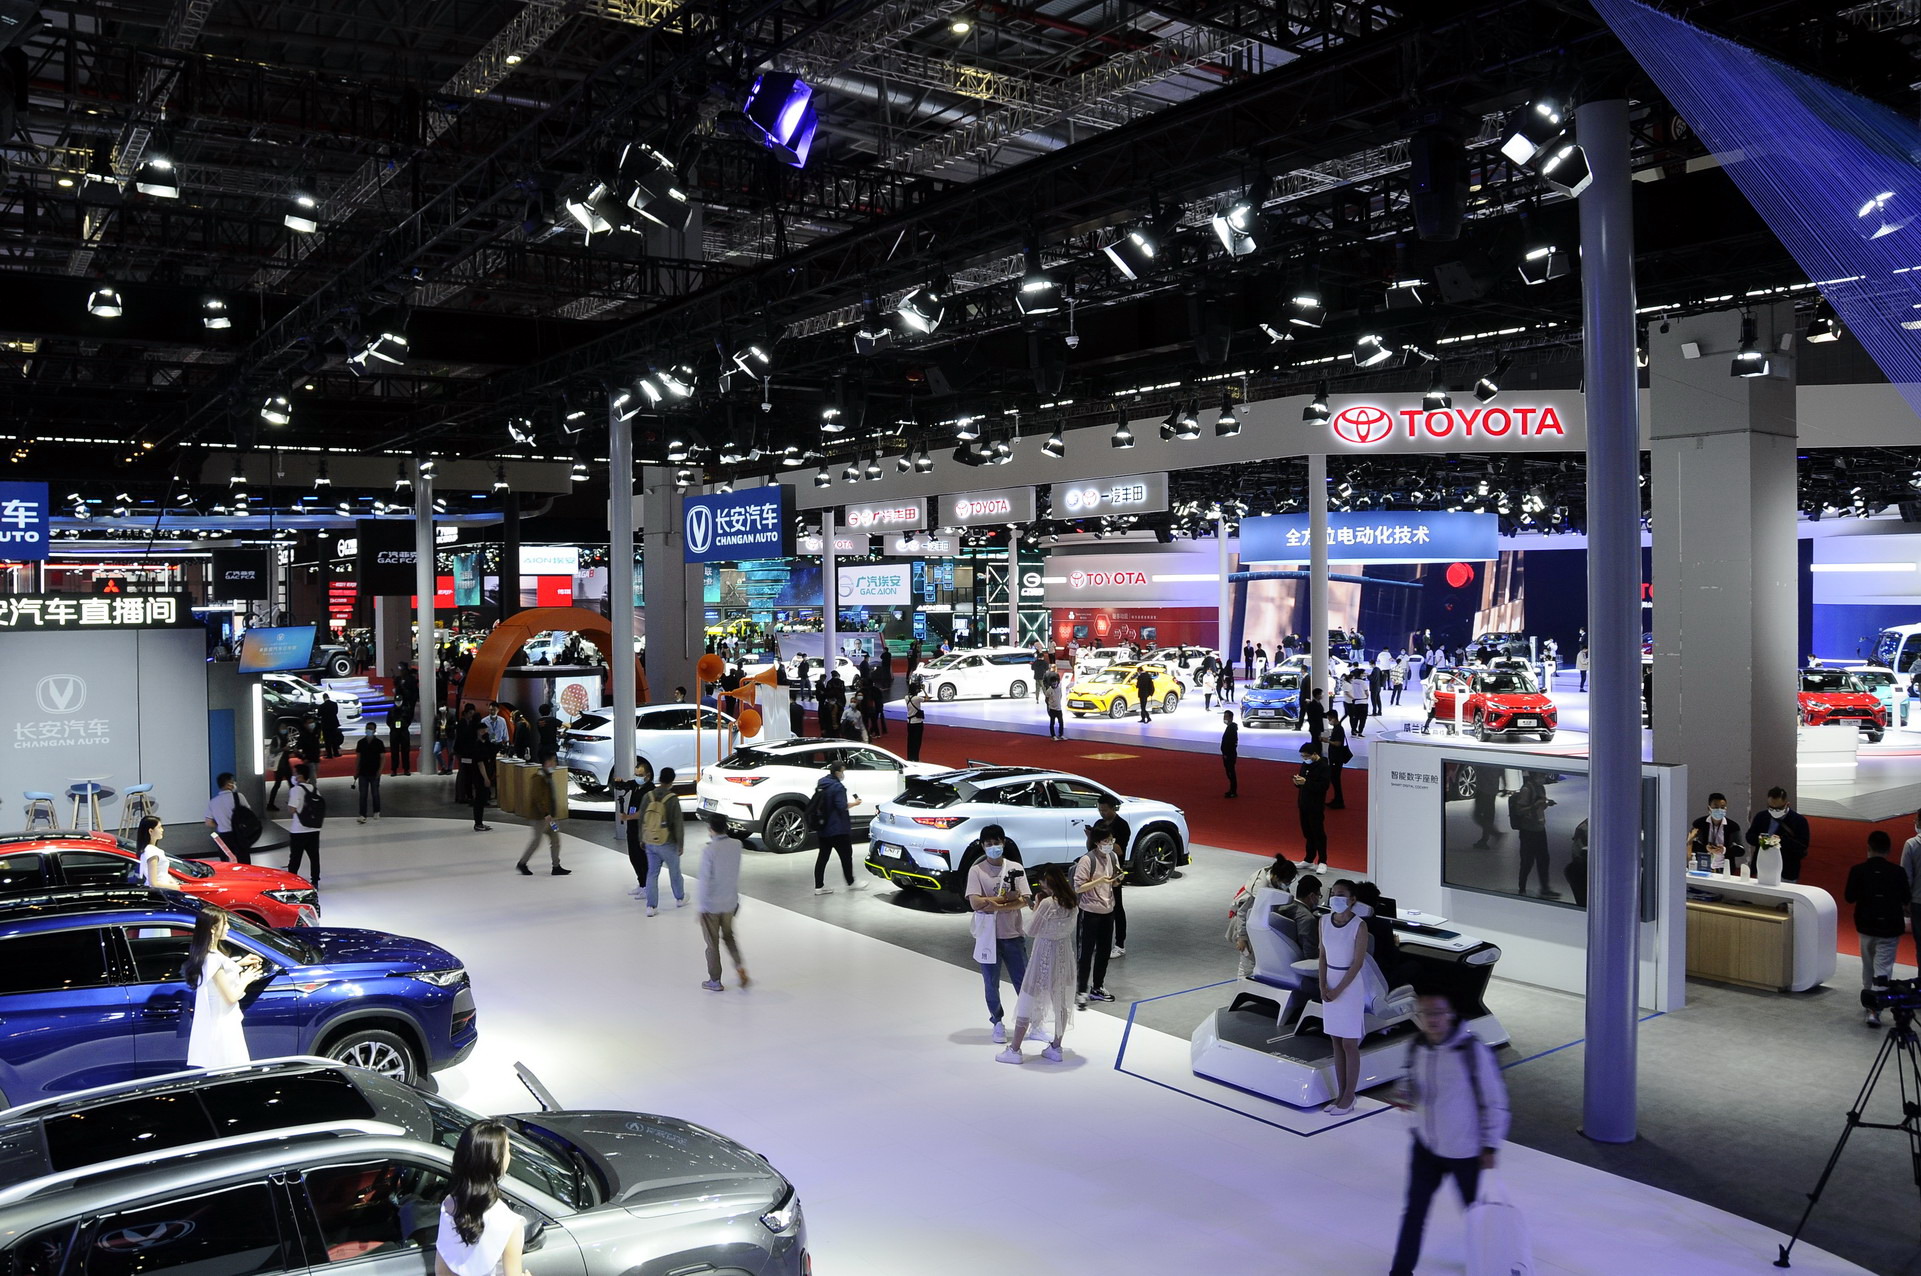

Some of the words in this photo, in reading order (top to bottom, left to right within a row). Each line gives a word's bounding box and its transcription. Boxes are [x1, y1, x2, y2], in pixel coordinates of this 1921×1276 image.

[1400, 408, 1564, 437] TOYOTA
[1101, 485, 1143, 503] 一汽丰田
[970, 500, 1008, 514] TOYOTA
[716, 503, 778, 534] 长安汽车
[716, 534, 754, 546] CHANGAN
[755, 532, 778, 543] AUTO
[856, 575, 901, 588] 广汽埃安
[1087, 572, 1147, 586] TOYOTA
[0, 597, 176, 626] 汽车直播间
[14, 718, 110, 740] 长安汽车
[14, 739, 75, 749] CHANGAN
[78, 737, 110, 745] AUTO
